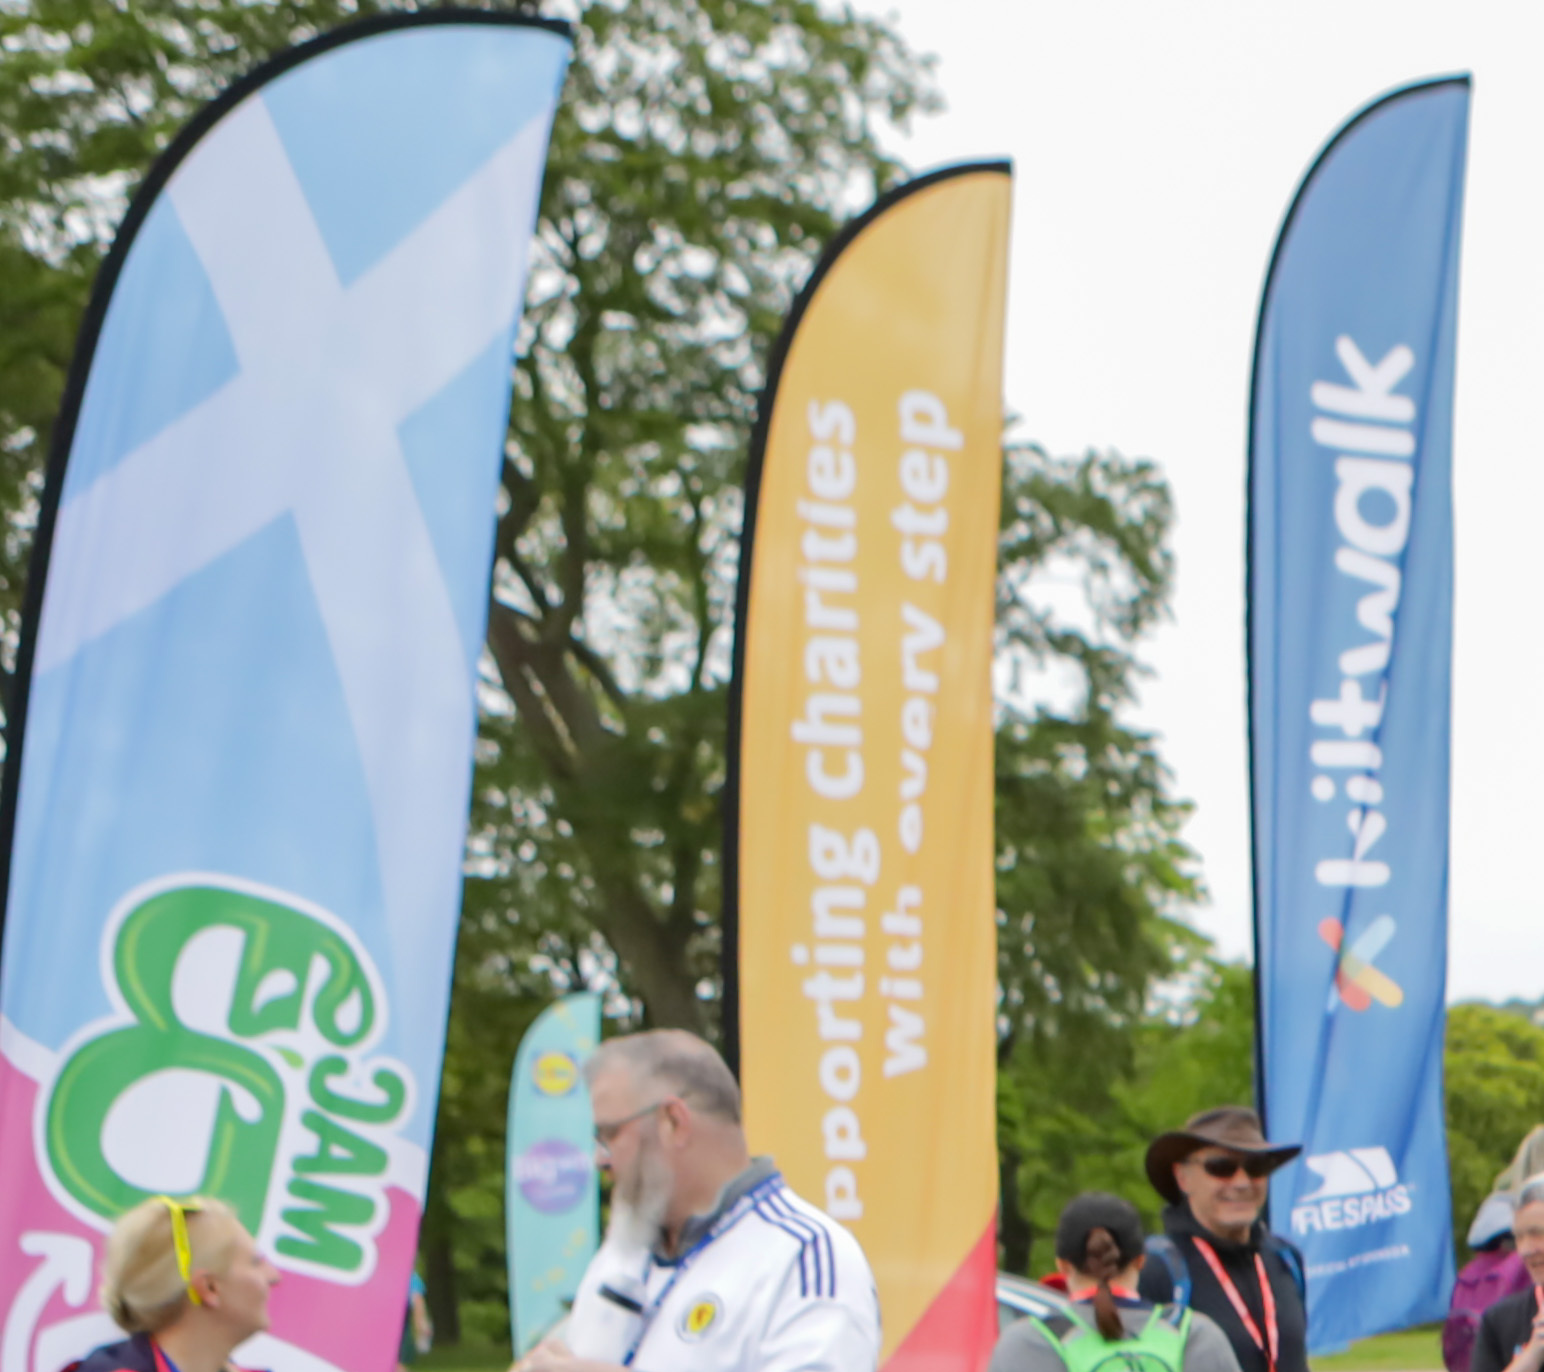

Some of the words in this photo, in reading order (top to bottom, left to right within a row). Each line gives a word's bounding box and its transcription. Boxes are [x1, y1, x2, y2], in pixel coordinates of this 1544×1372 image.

[791, 398, 865, 799] charities
[891, 389, 964, 584] step
[1311, 334, 1415, 887] kiltwalk
[899, 599, 947, 854] every
[790, 823, 881, 1220] pporting
[881, 884, 928, 1079] with
